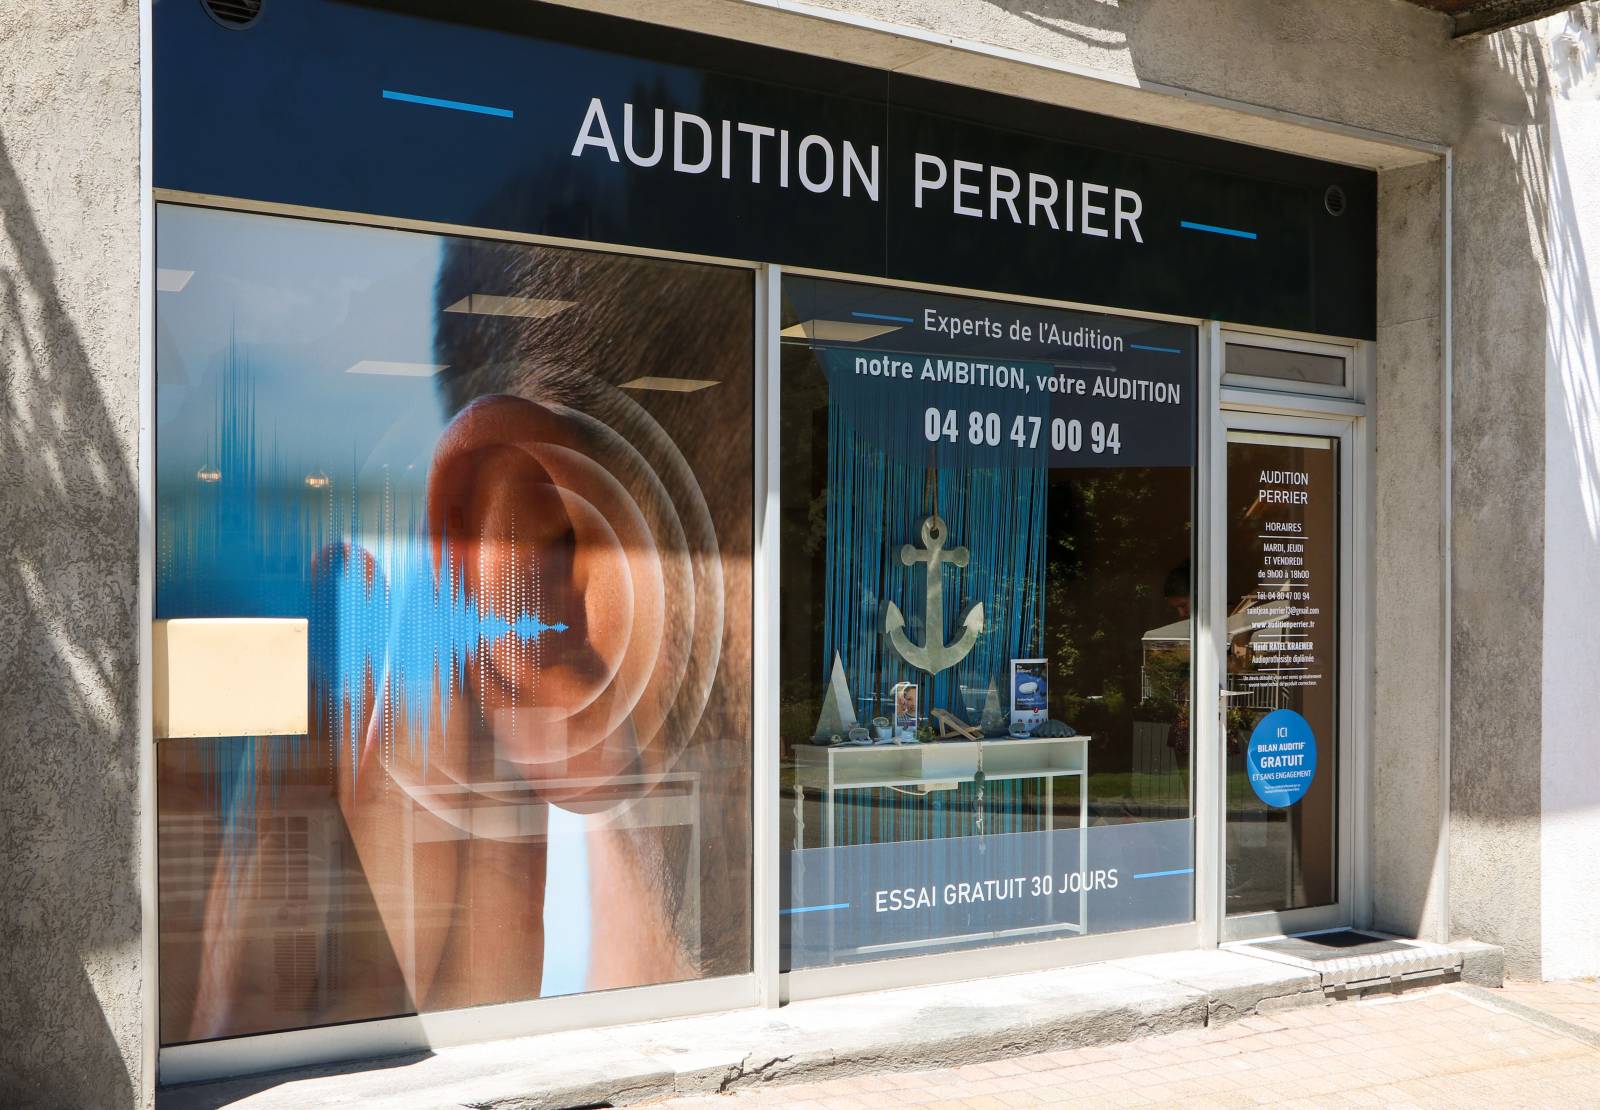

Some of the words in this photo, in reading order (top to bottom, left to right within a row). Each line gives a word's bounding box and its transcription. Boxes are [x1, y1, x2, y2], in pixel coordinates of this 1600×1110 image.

[571, 97, 880, 202] AUDITION
[913, 152, 1144, 244] PERRIER
[923, 308, 1002, 340] Experts
[1009, 319, 1032, 342] de
[1039, 322, 1124, 352] l'Audition
[855, 356, 914, 379] notre
[920, 358, 1030, 395] AMBITION,
[1036, 374, 1086, 396] votre
[1092, 376, 1181, 405] AUDITION
[924, 407, 959, 443] 04
[968, 411, 1001, 446] 80
[1010, 415, 1042, 449] 47
[1051, 417, 1082, 452] 00
[1091, 421, 1121, 454] 94
[1259, 470, 1309, 486] AUDITION
[1259, 489, 1308, 505] PERRIER
[1265, 521, 1302, 533] HORAIRES
[1263, 543, 1286, 553] MARDI,
[1287, 544, 1304, 553] JEUDI
[1264, 556, 1271, 565] ET
[1273, 556, 1303, 566] VENDREDI
[1257, 569, 1266, 578] de
[1267, 569, 1283, 579] 9h00
[1284, 570, 1289, 579] à
[1291, 570, 1310, 579] 18h00
[1267, 591, 1276, 600] 04
[1277, 591, 1285, 600] 80
[1286, 591, 1292, 600] 47
[1293, 591, 1301, 600] 00
[1302, 591, 1310, 600] 94
[1277, 727, 1288, 738] ICI
[1257, 743, 1278, 753] BILAN
[1279, 742, 1306, 751] AUDITIF
[1260, 754, 1304, 768] GRATUIT
[1252, 773, 1259, 781] ET
[1260, 772, 1275, 781] SANS
[1275, 769, 1312, 780] ENGAGEMENT
[875, 886, 936, 913] ESSAI
[944, 877, 1027, 905] GRATUIT
[1031, 875, 1053, 896] 30
[1059, 868, 1120, 894] JOURS
